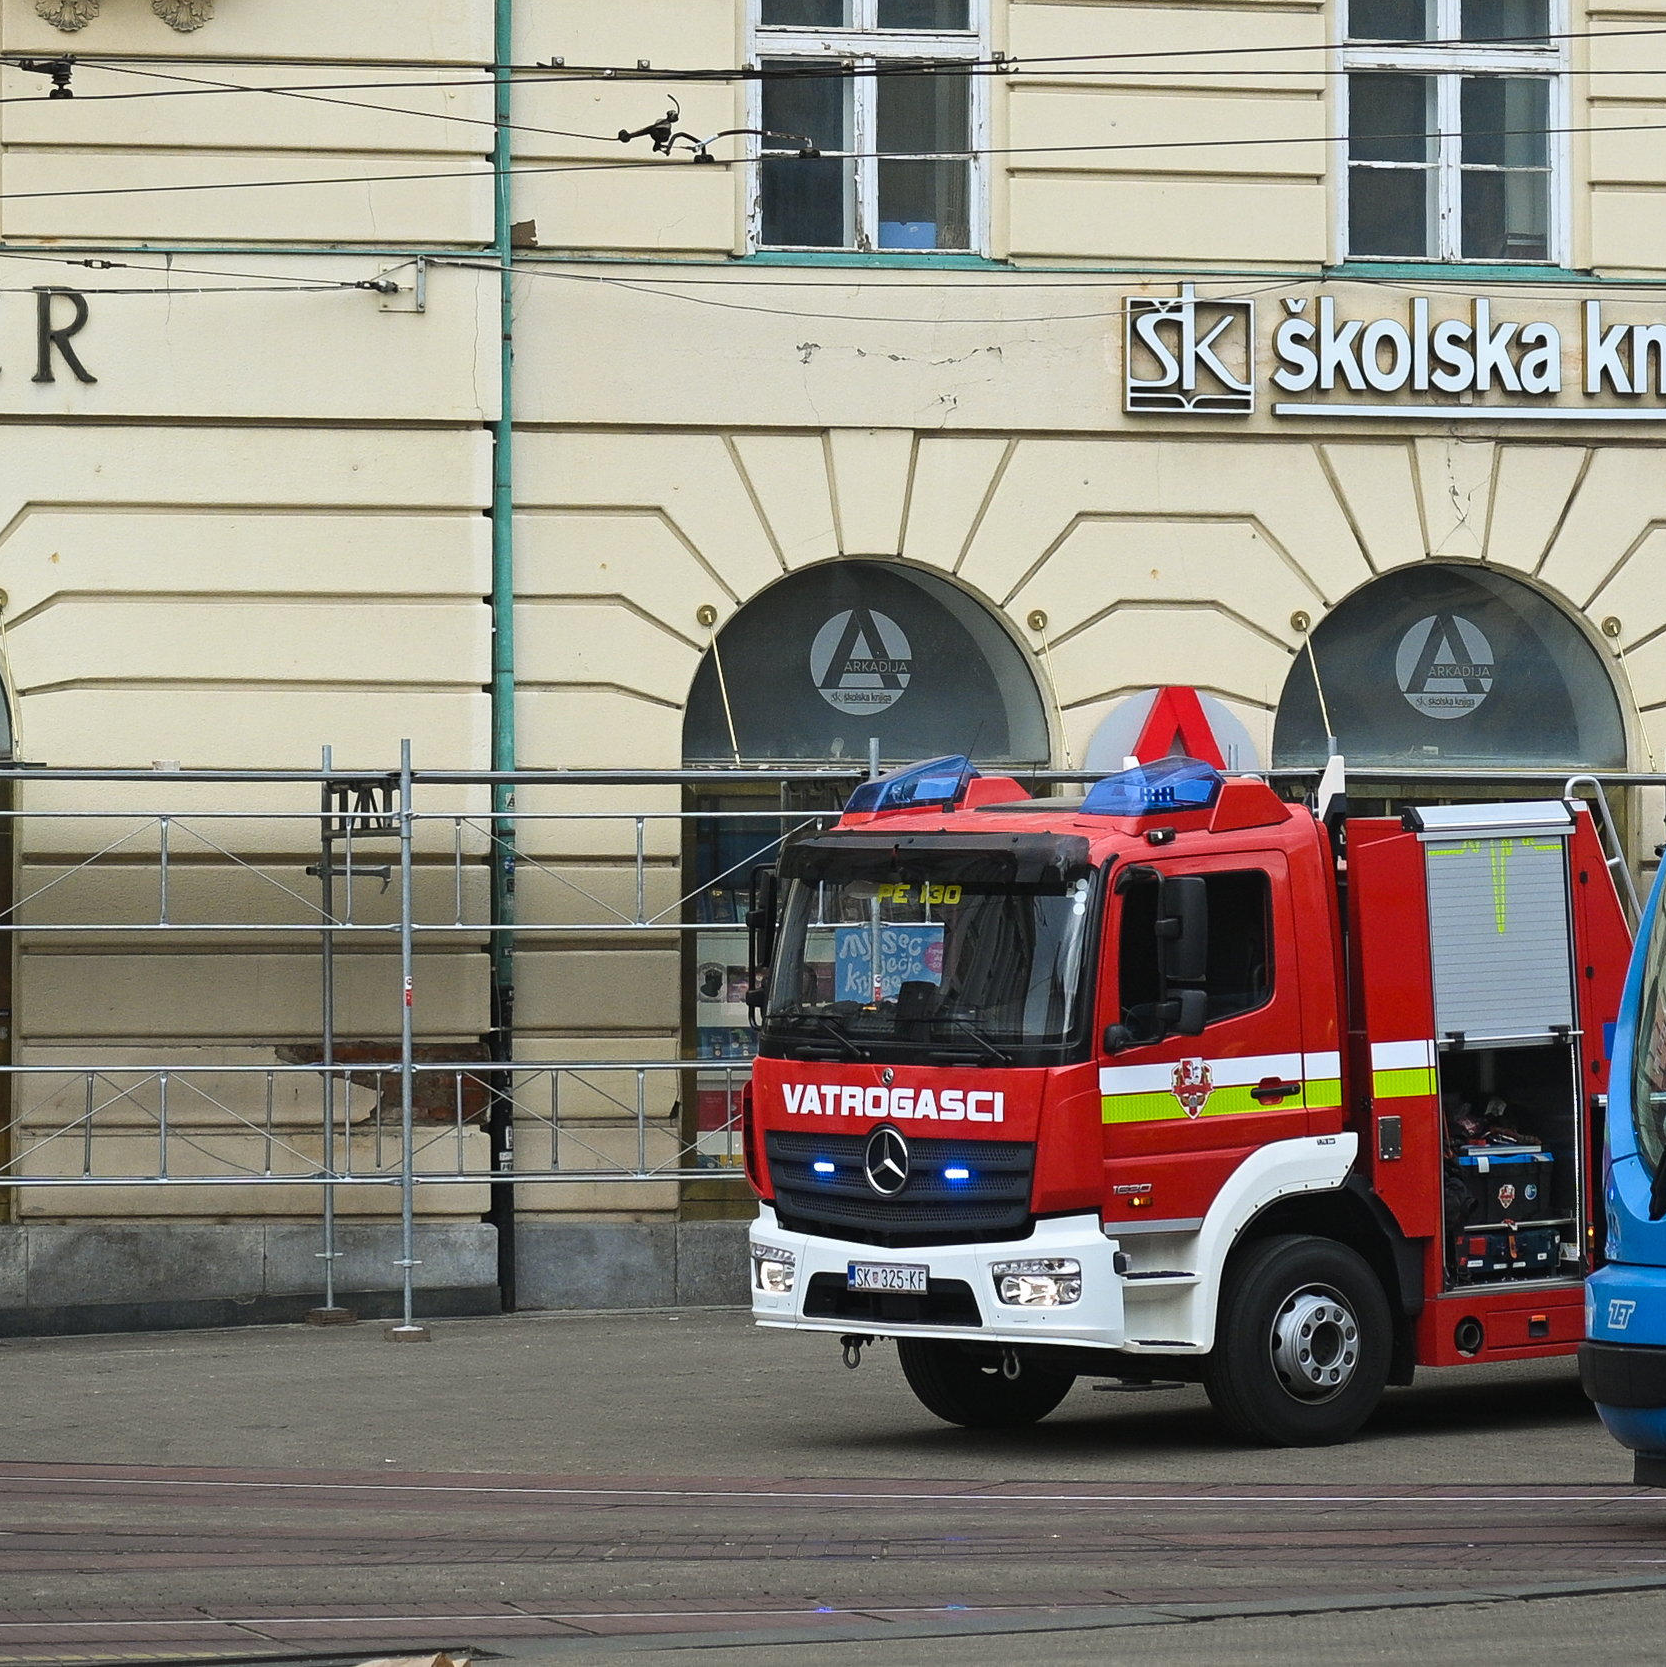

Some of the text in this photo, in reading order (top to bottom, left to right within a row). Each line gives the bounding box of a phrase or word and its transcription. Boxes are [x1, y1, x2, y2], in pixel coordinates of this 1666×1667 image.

[1272, 295, 1561, 394] školska
[844, 661, 908, 673] ARKADIJA
[1428, 666, 1491, 677] ARKADIJA
[878, 884, 911, 903] PE
[782, 1083, 1004, 1122] VATROGASCI
[856, 1268, 925, 1290] SK 325-KF
